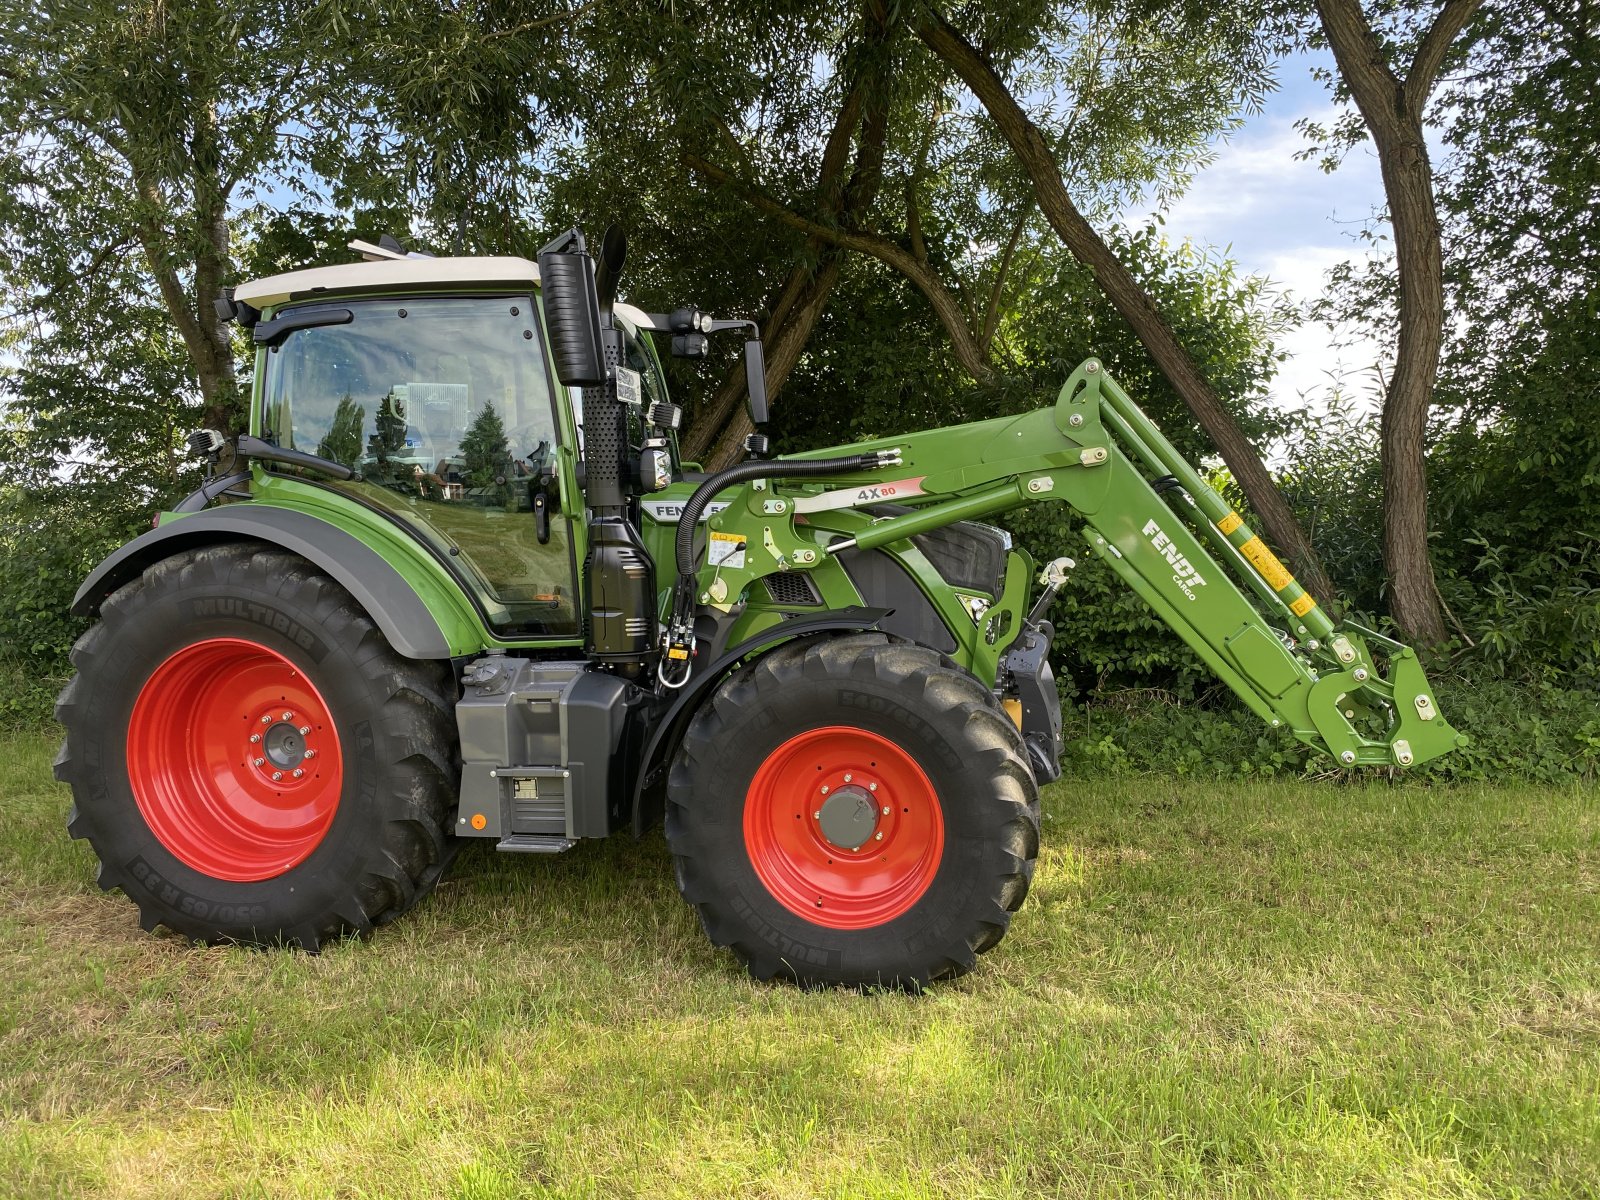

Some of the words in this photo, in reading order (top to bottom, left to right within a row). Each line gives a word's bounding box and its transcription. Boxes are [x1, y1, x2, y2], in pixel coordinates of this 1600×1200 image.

[858, 488, 880, 500] 4X
[881, 487, 896, 497] 80
[656, 506, 704, 517] FEN
[1142, 519, 1207, 587] FENDT
[1172, 574, 1196, 601] CARGO
[192, 598, 315, 651] MULTIBIB
[130, 859, 160, 891] 38
[158, 883, 179, 905] R
[726, 894, 828, 965] MULTIBIB
